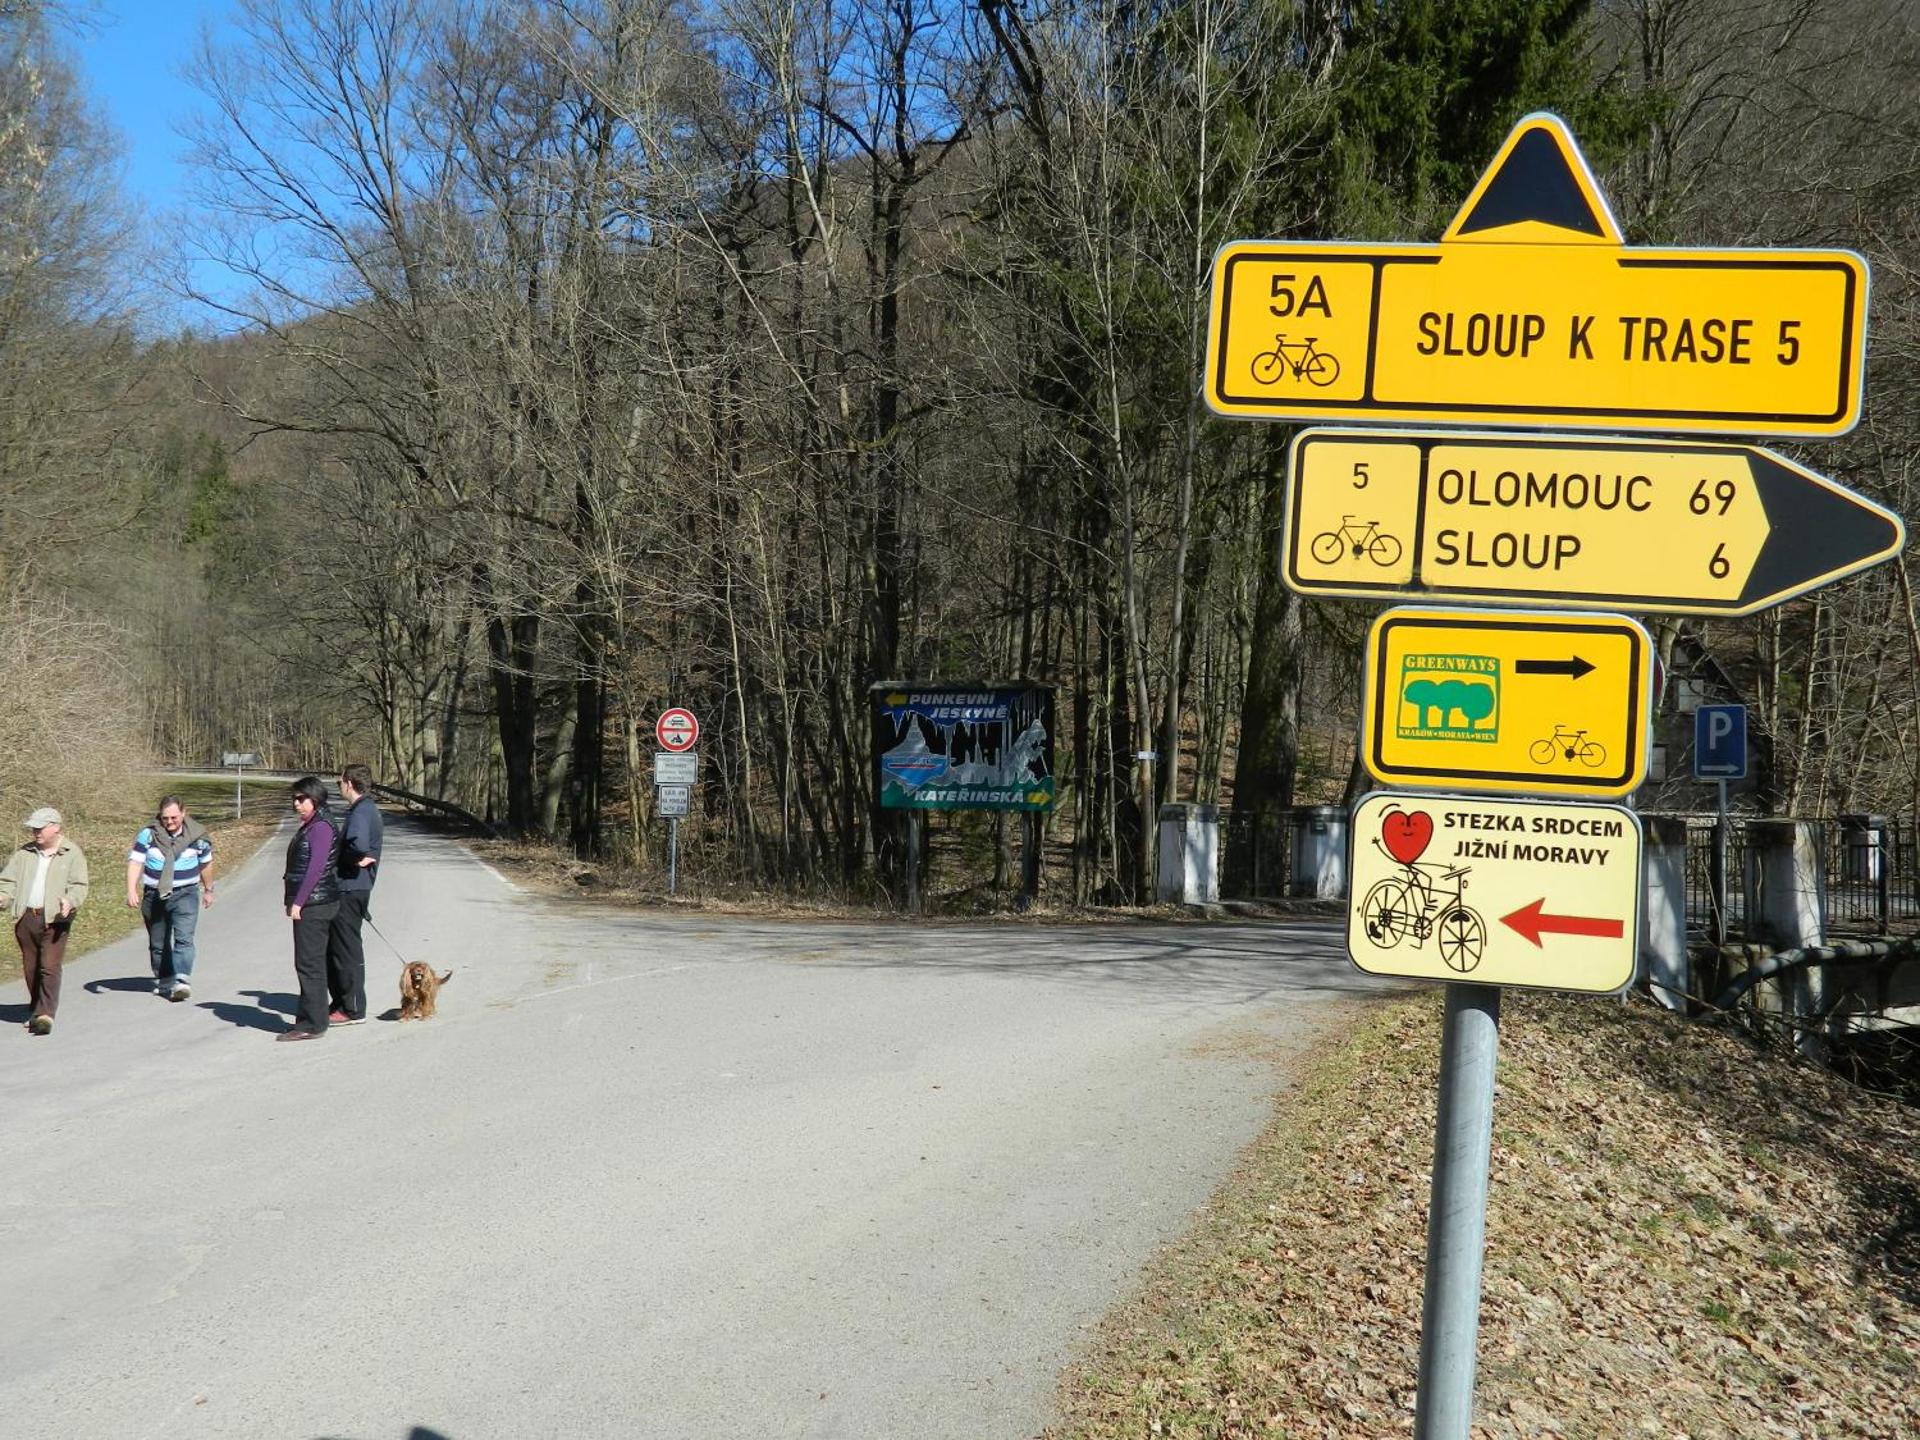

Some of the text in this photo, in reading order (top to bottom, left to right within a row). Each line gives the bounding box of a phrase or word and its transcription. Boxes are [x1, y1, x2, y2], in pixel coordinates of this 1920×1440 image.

[1269, 274, 1332, 319] 5A
[1417, 311, 1801, 366] SLOUP K TRASE 5
[1352, 463, 1369, 490] 5
[1437, 468, 1736, 516] OLOMOUC 69
[1435, 529, 1730, 580] SLOUP 6
[1405, 655, 1497, 672] GREENWAYS
[930, 705, 1009, 719] JESKYNĚ
[1709, 711, 1733, 750] P
[914, 787, 1025, 803] KATEŘINSKÁ
[1443, 811, 1623, 838] STEZKA SRDCEM
[1453, 839, 1610, 865] JIŽNÍ MORAVY
